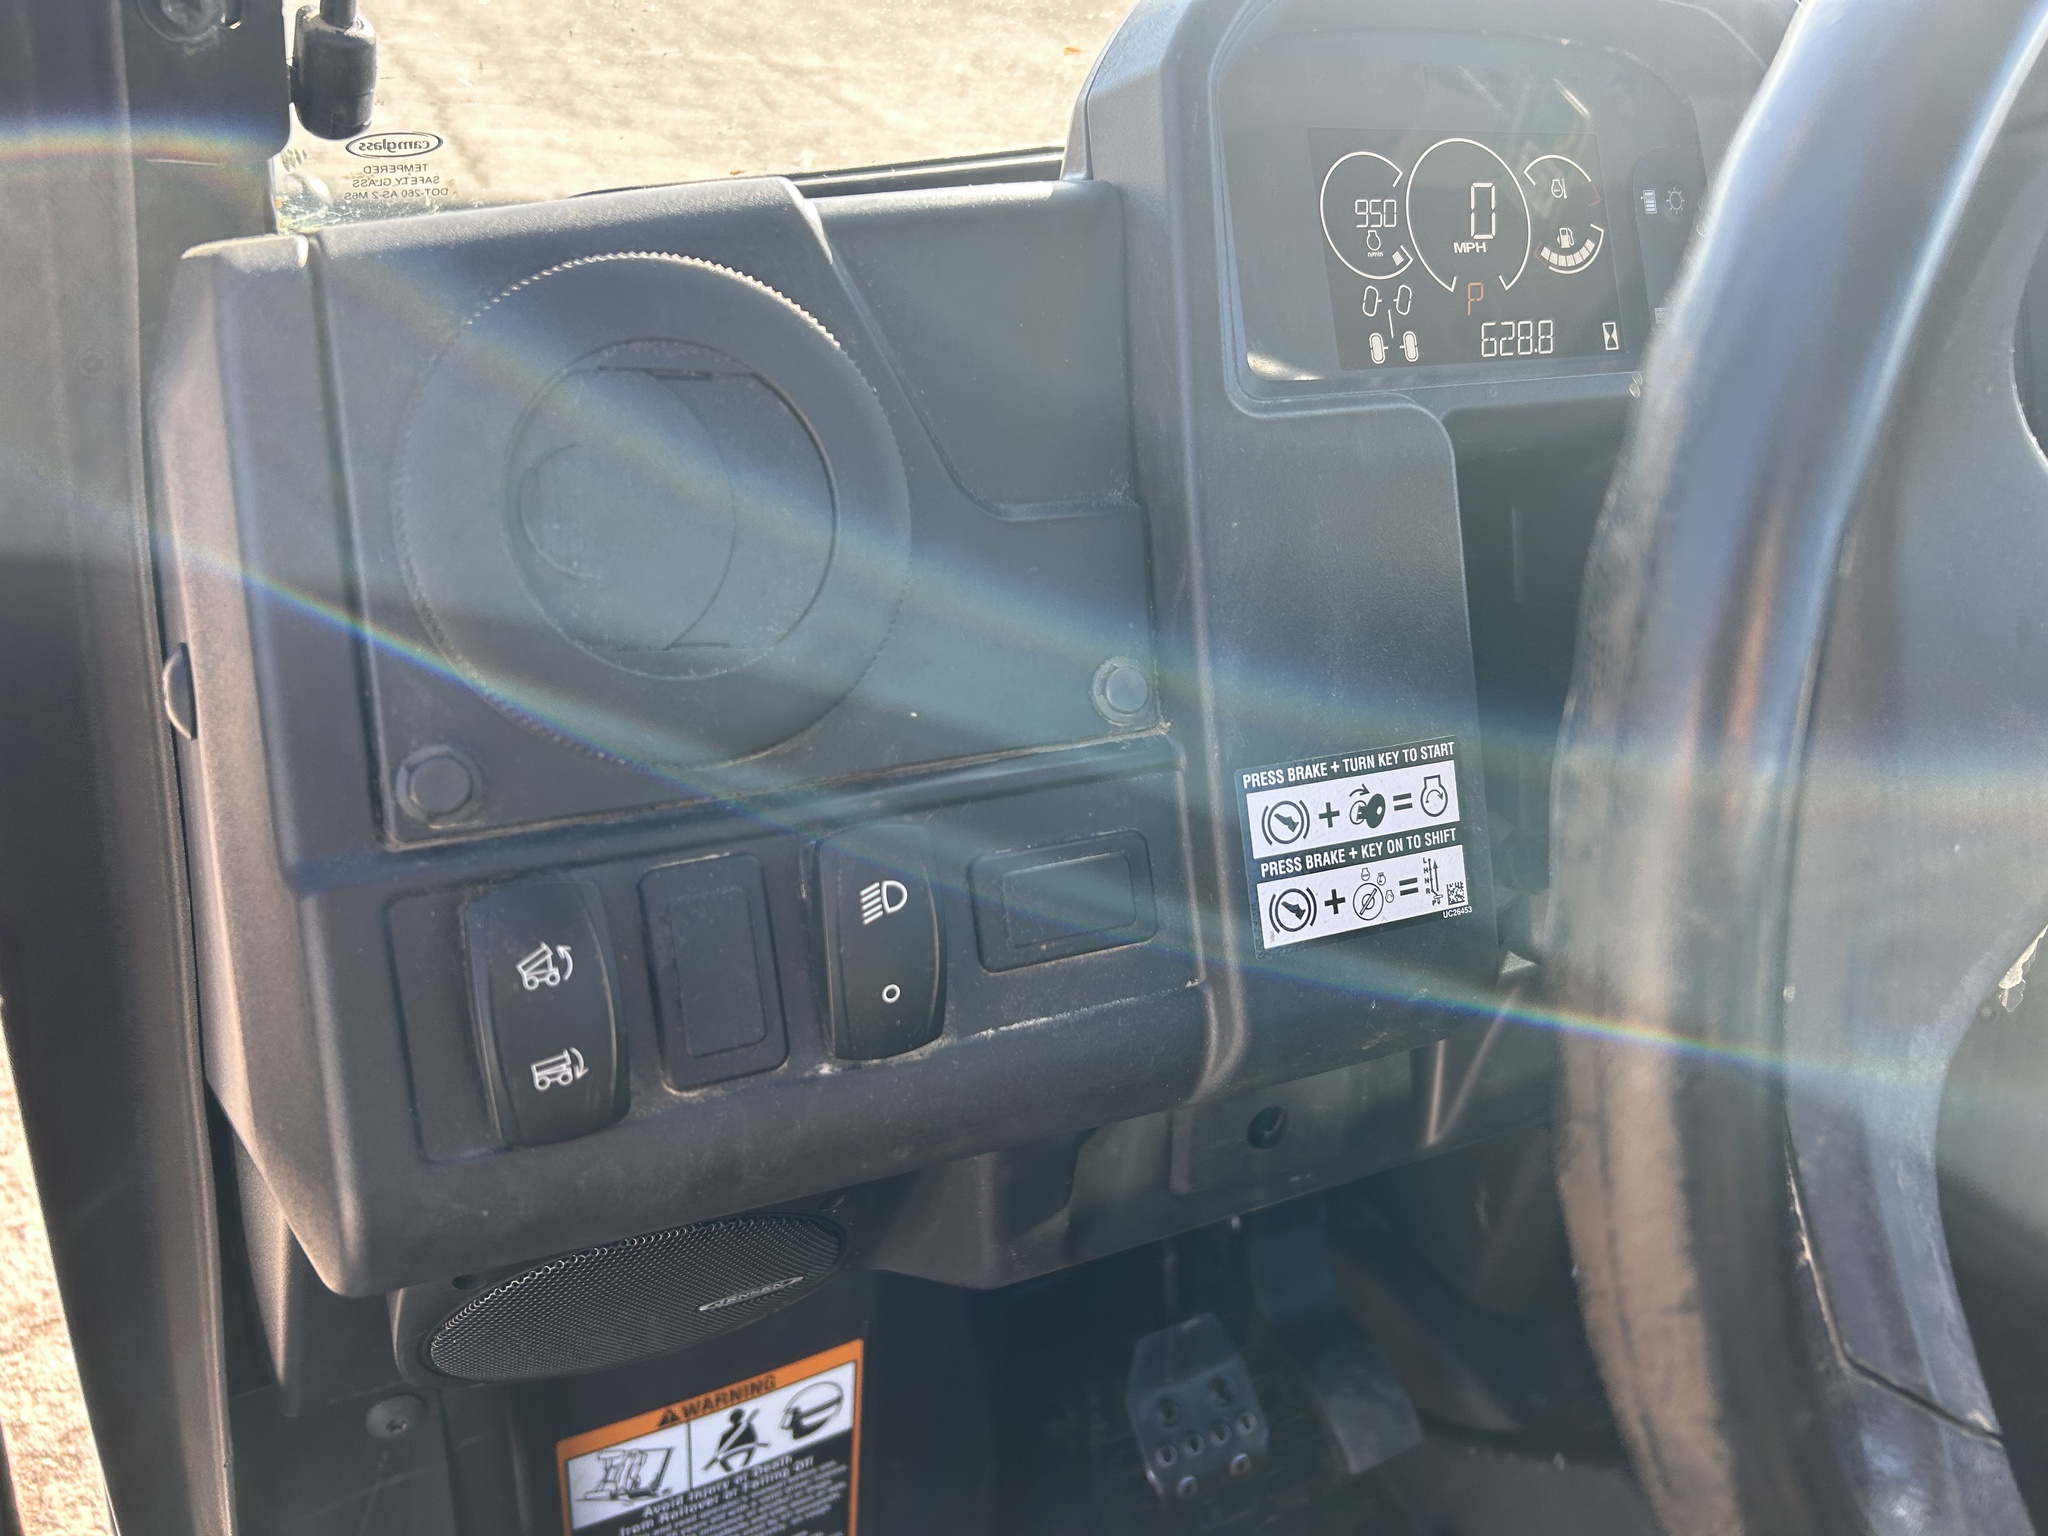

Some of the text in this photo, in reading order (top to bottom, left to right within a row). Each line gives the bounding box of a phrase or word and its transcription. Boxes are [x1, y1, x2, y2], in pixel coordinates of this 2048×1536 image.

[1354, 199, 1397, 228] 950
[1470, 182, 1496, 239] 0
[1453, 241, 1487, 254] MPH
[1467, 282, 1484, 316] P
[1481, 319, 1554, 357] 628.8
[1242, 769, 1284, 788] PRESS
[1287, 762, 1328, 782] BRAKE
[1342, 754, 1376, 773] TURN
[1378, 750, 1400, 768] KEY
[1402, 748, 1417, 763] TO
[1420, 742, 1455, 760] START
[1261, 857, 1303, 878] PRESS
[1305, 849, 1346, 870] BRAKE
[1361, 841, 1383, 859] KEY
[1386, 838, 1404, 854] ON
[1406, 834, 1421, 850] TO
[1424, 828, 1457, 847] SHIFT
[1442, 905, 1473, 919] UC26453
[683, 1374, 777, 1419] WARNING
[642, 1455, 793, 1519] Avoid Injury or Death
[659, 1491, 719, 1525] Rollover
